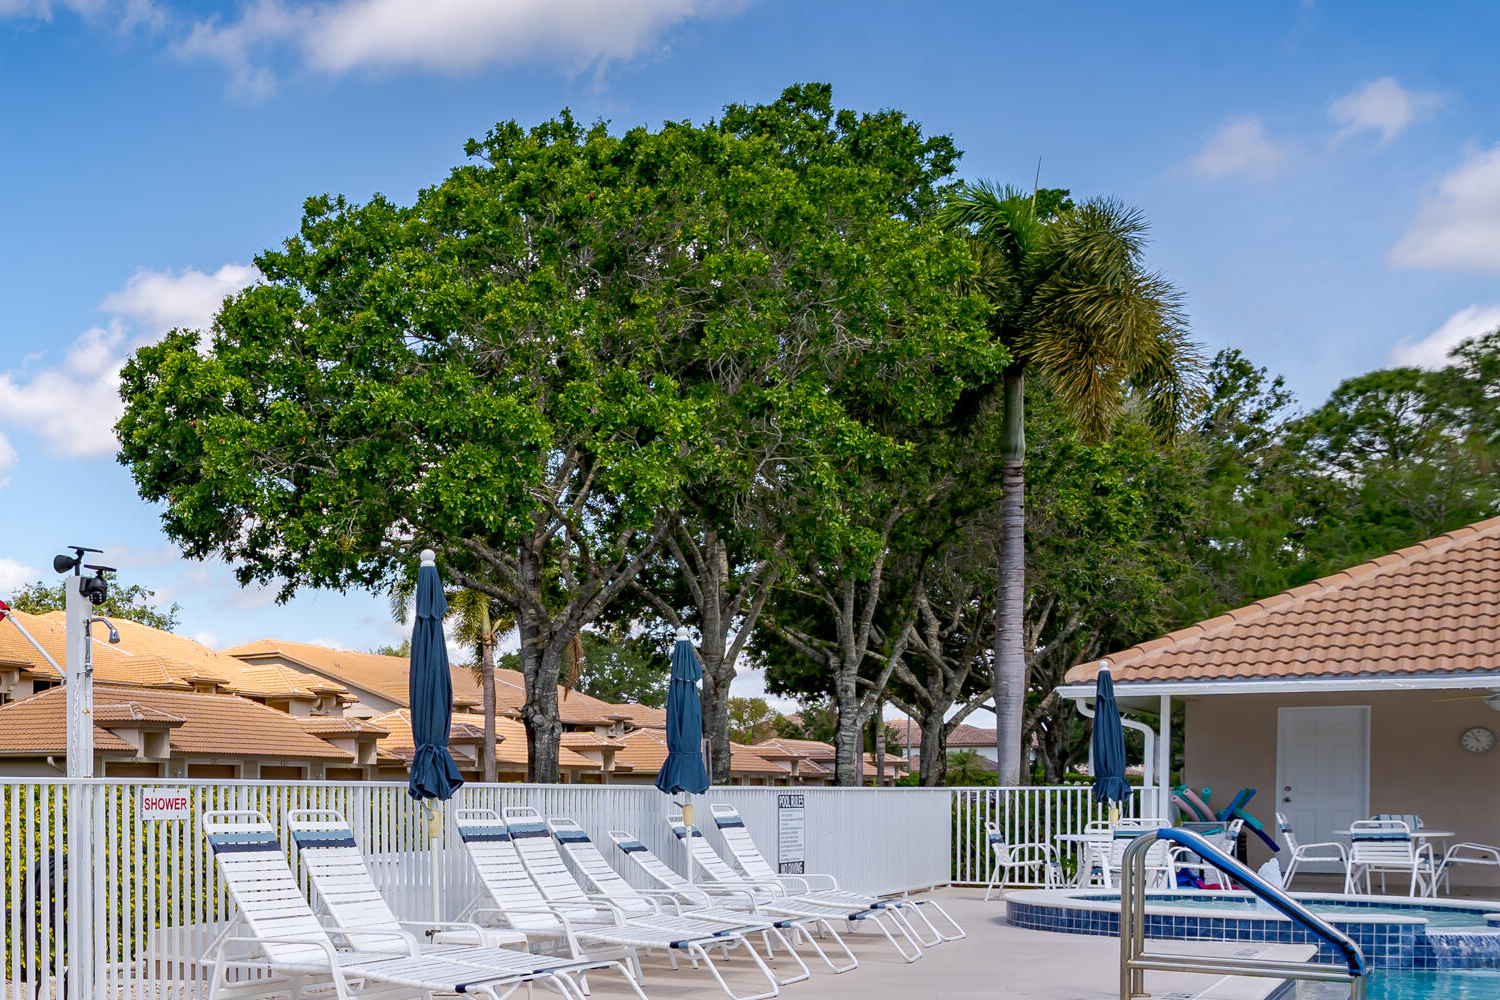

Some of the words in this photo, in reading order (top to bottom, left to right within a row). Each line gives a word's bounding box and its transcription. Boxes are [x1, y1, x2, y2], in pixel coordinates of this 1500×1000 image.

[144, 798, 187, 810] SHOWER
[779, 795, 791, 808] POOL
[791, 795, 804, 808] RULES
[780, 863, 788, 874] NO
[788, 862, 803, 874] DIVING
